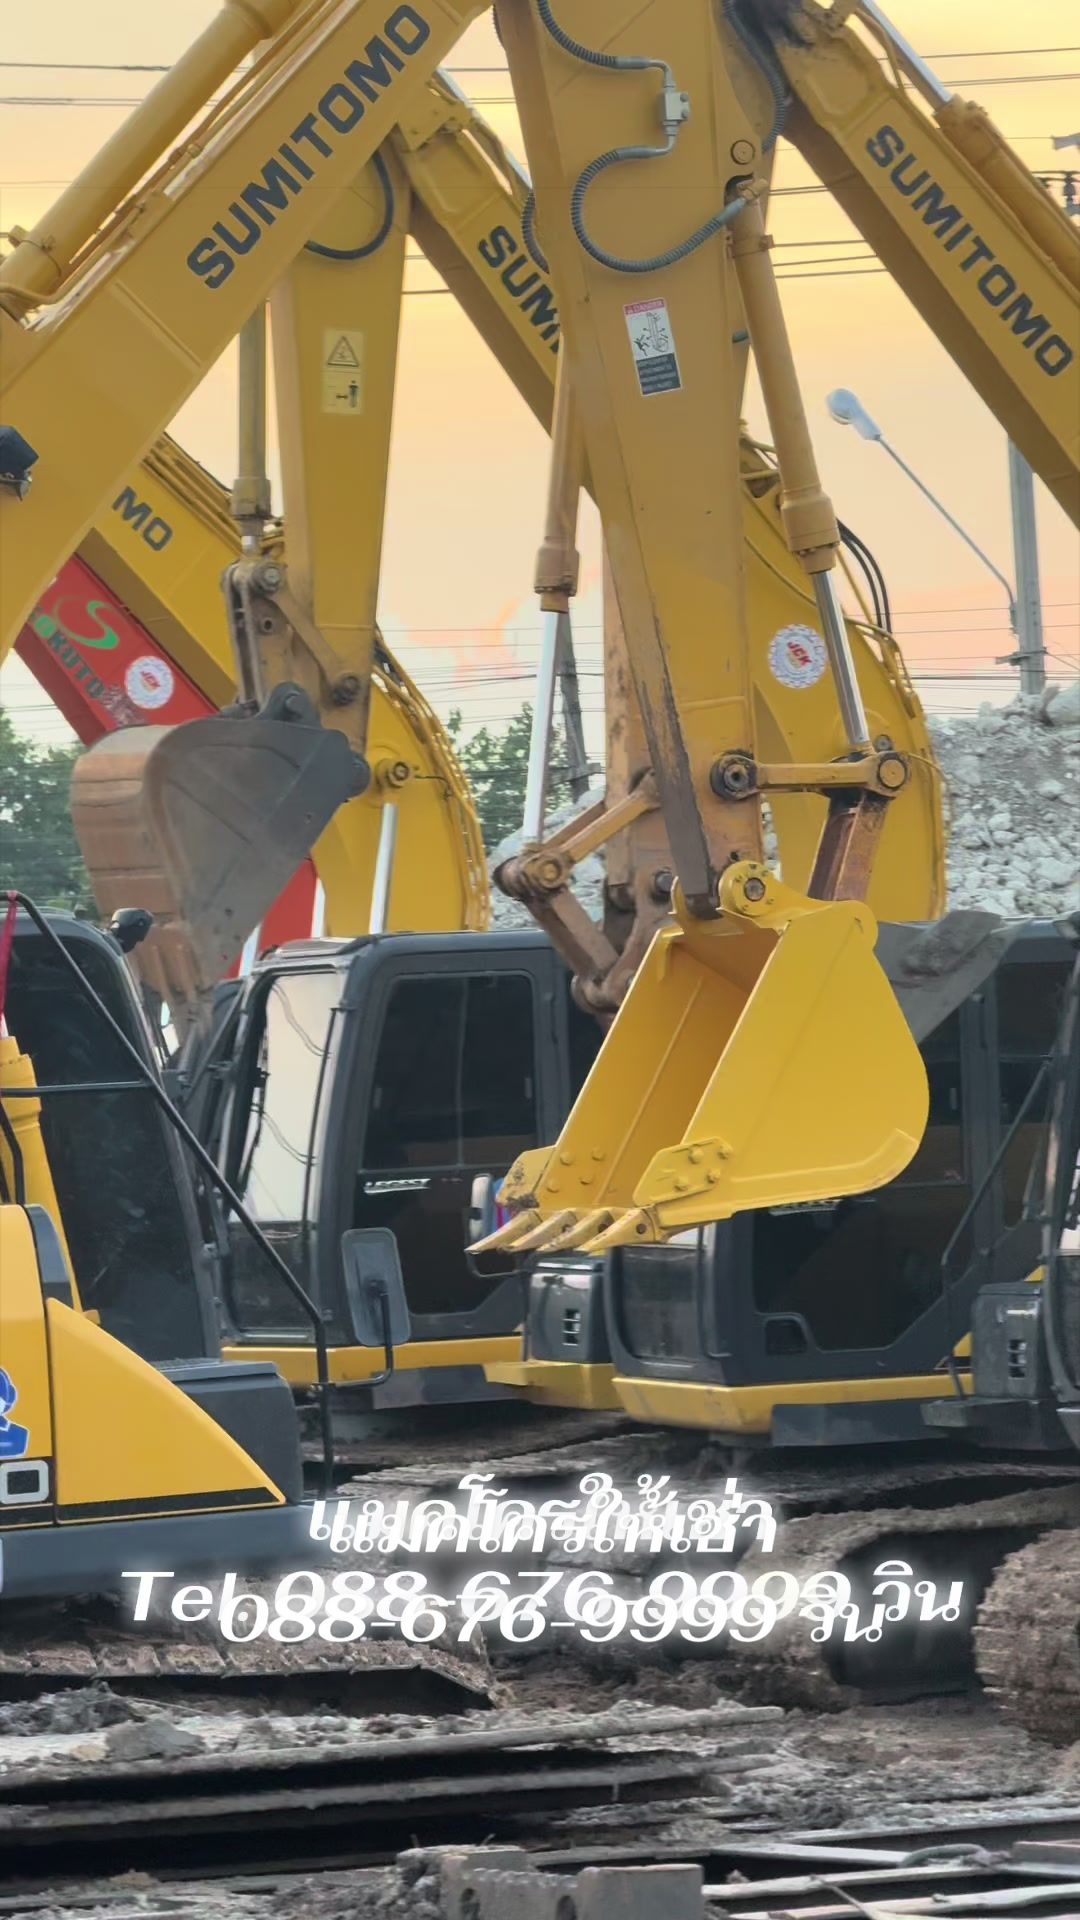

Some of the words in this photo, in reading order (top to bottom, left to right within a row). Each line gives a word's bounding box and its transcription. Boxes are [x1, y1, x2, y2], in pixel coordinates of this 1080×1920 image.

[186, 5, 431, 290] SUMITOMO
[865, 124, 1074, 378] SUMITOMO
[478, 225, 560, 354] SUMI
